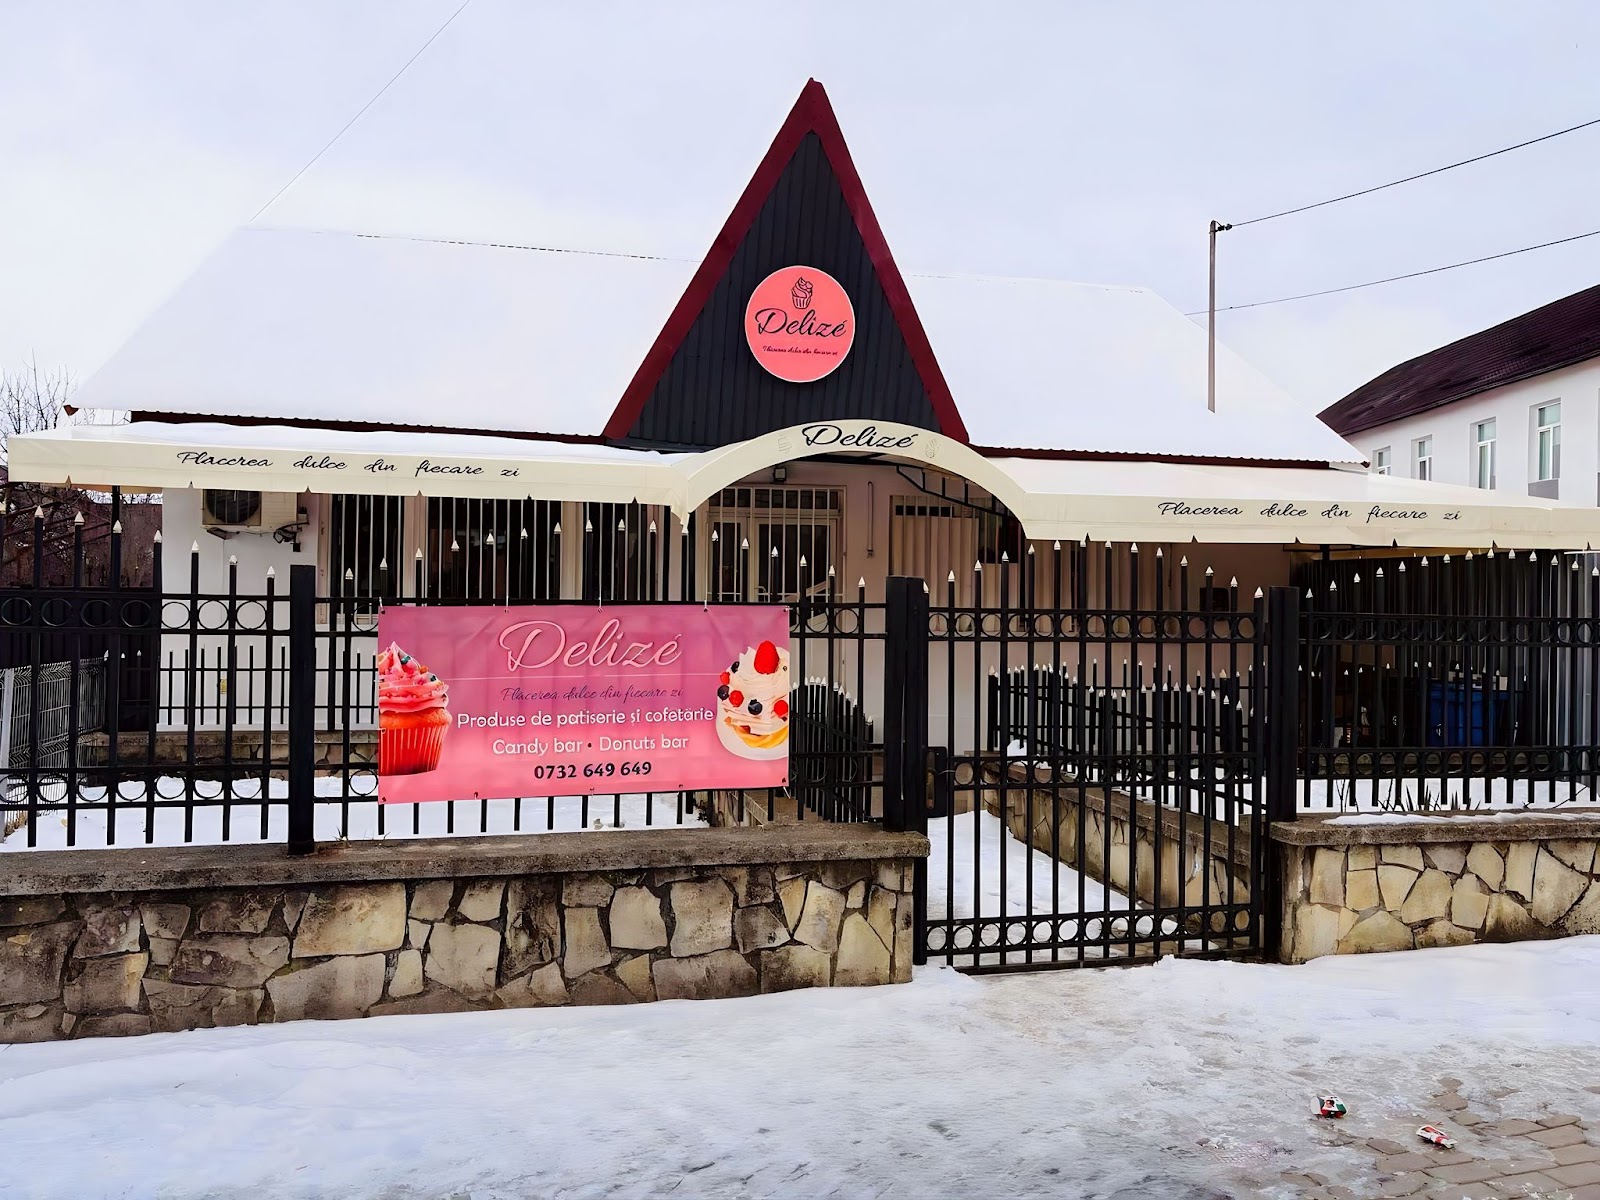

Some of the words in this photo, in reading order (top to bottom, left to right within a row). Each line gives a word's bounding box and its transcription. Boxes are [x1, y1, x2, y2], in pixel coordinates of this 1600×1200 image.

[754, 308, 848, 338] Delizé
[801, 424, 919, 448] Delizé
[176, 451, 274, 467] Placerea
[292, 455, 348, 470] dulce
[363, 458, 398, 473] din
[414, 459, 485, 477] fiecare
[500, 468, 520, 477] zi
[1157, 501, 1243, 516] Placerea
[1260, 502, 1309, 517] dulce
[1320, 503, 1353, 519] din
[1365, 505, 1429, 524] fiecare
[1442, 510, 1463, 520] zi
[498, 618, 683, 673] Delizé
[562, 685, 598, 701] dulce
[599, 685, 622, 700] din
[456, 711, 527, 729] Produse
[530, 710, 553, 727] de
[556, 707, 627, 729] patiserie
[492, 738, 549, 757] Candy
[553, 737, 584, 753] bar
[599, 736, 657, 752] Donuts
[660, 733, 690, 750] bar
[533, 764, 578, 780] 0732
[582, 762, 616, 778] 649
[619, 761, 653, 776] 649
